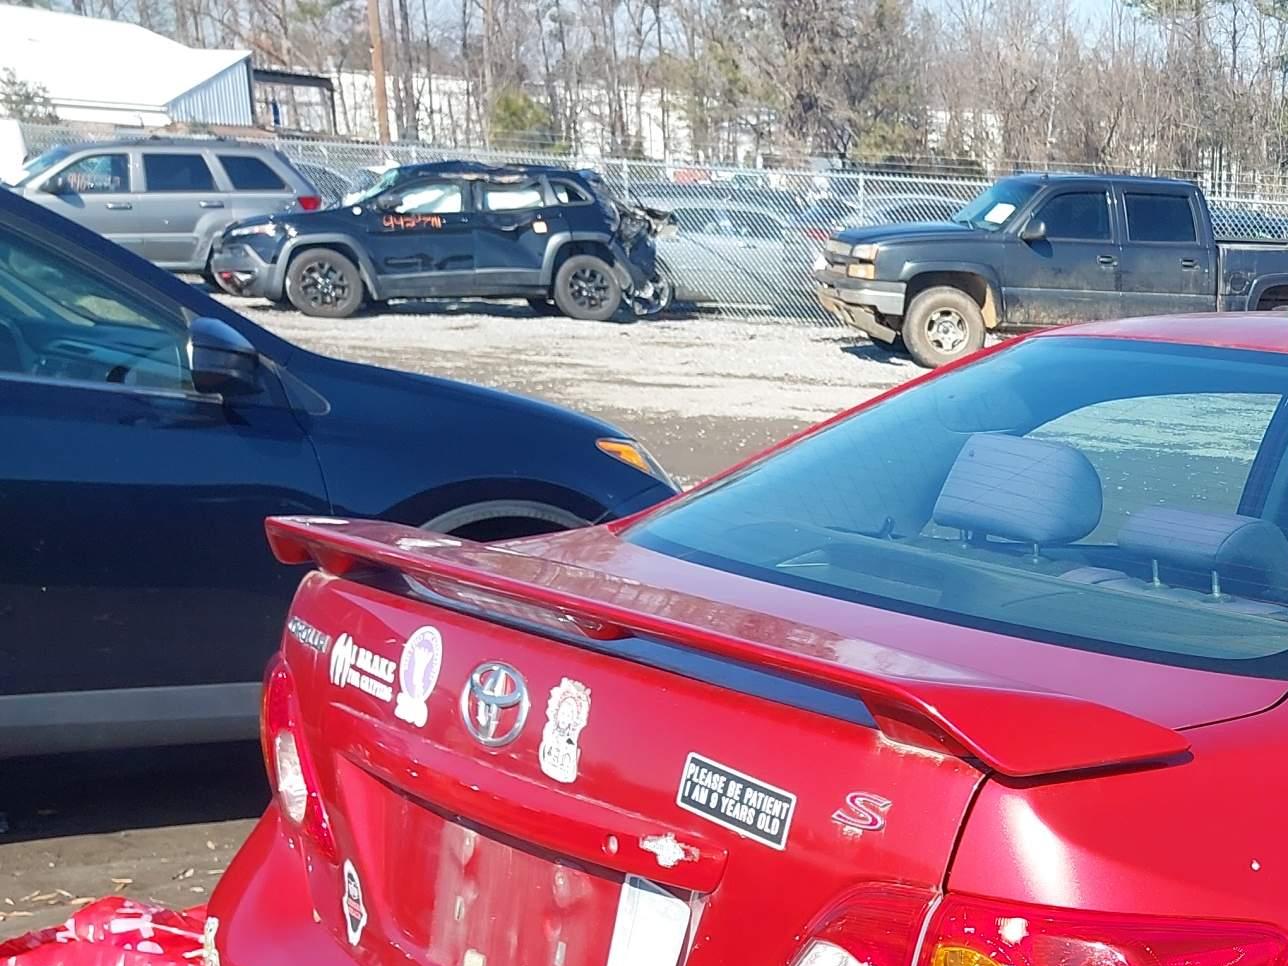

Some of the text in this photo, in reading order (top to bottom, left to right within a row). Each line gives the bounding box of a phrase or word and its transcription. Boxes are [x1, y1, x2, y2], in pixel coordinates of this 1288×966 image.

[684, 780, 691, 797] I
[691, 786, 709, 805] AM
[720, 797, 755, 826] YEARS
[756, 811, 780, 836] OLD
[686, 762, 790, 820] PLEASE BE PATIENT
[832, 791, 892, 831] S
